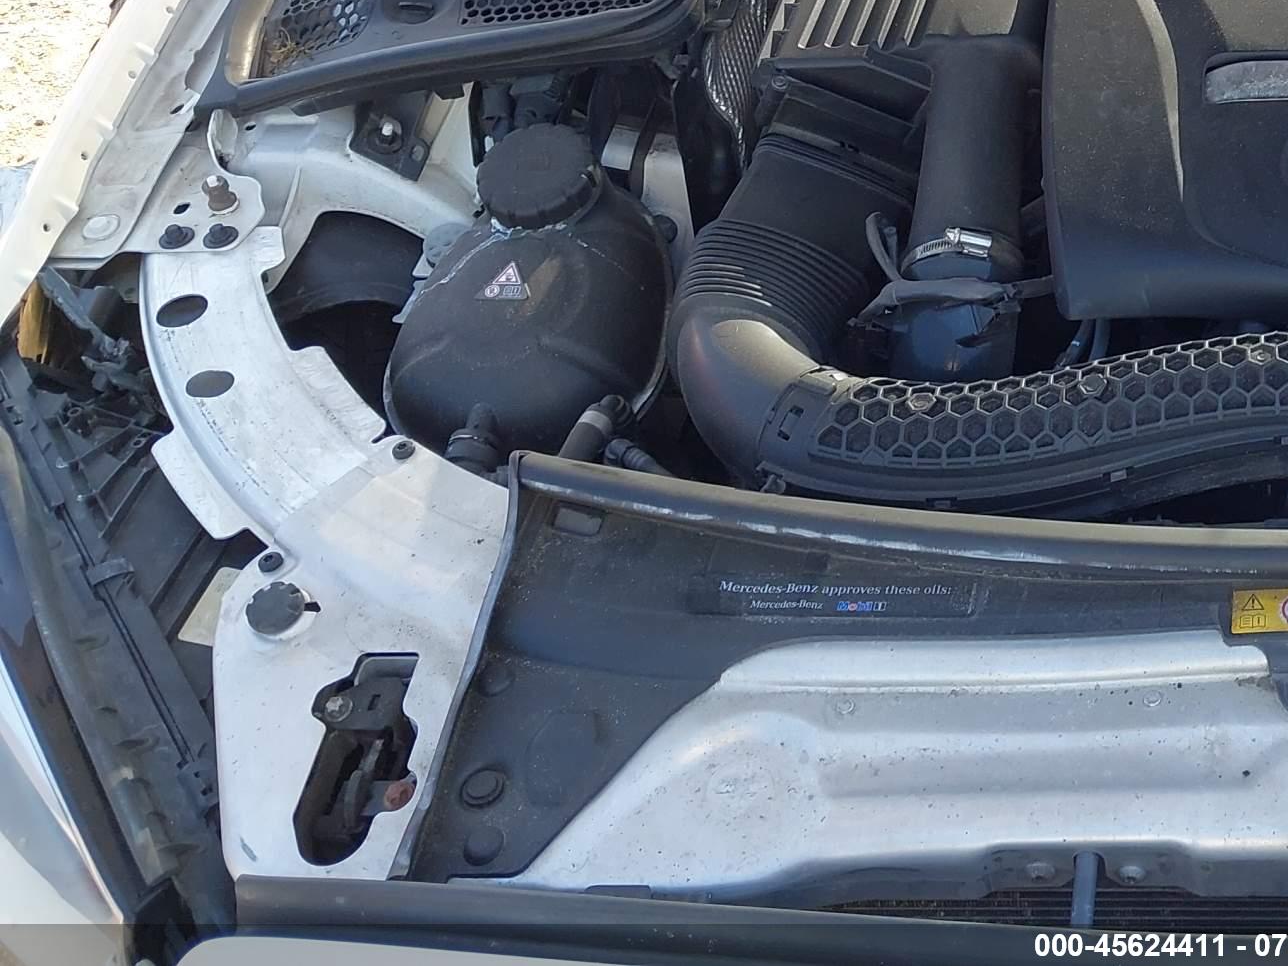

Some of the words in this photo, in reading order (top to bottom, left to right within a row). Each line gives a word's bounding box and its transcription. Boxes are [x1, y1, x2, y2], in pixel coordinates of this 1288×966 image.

[719, 580, 819, 595] Mercedes-Benz
[821, 585, 882, 597] approves
[885, 584, 921, 596] these
[924, 583, 952, 596] oils:
[750, 599, 824, 611] Mercedes-Benz
[837, 600, 873, 612] Mobil
